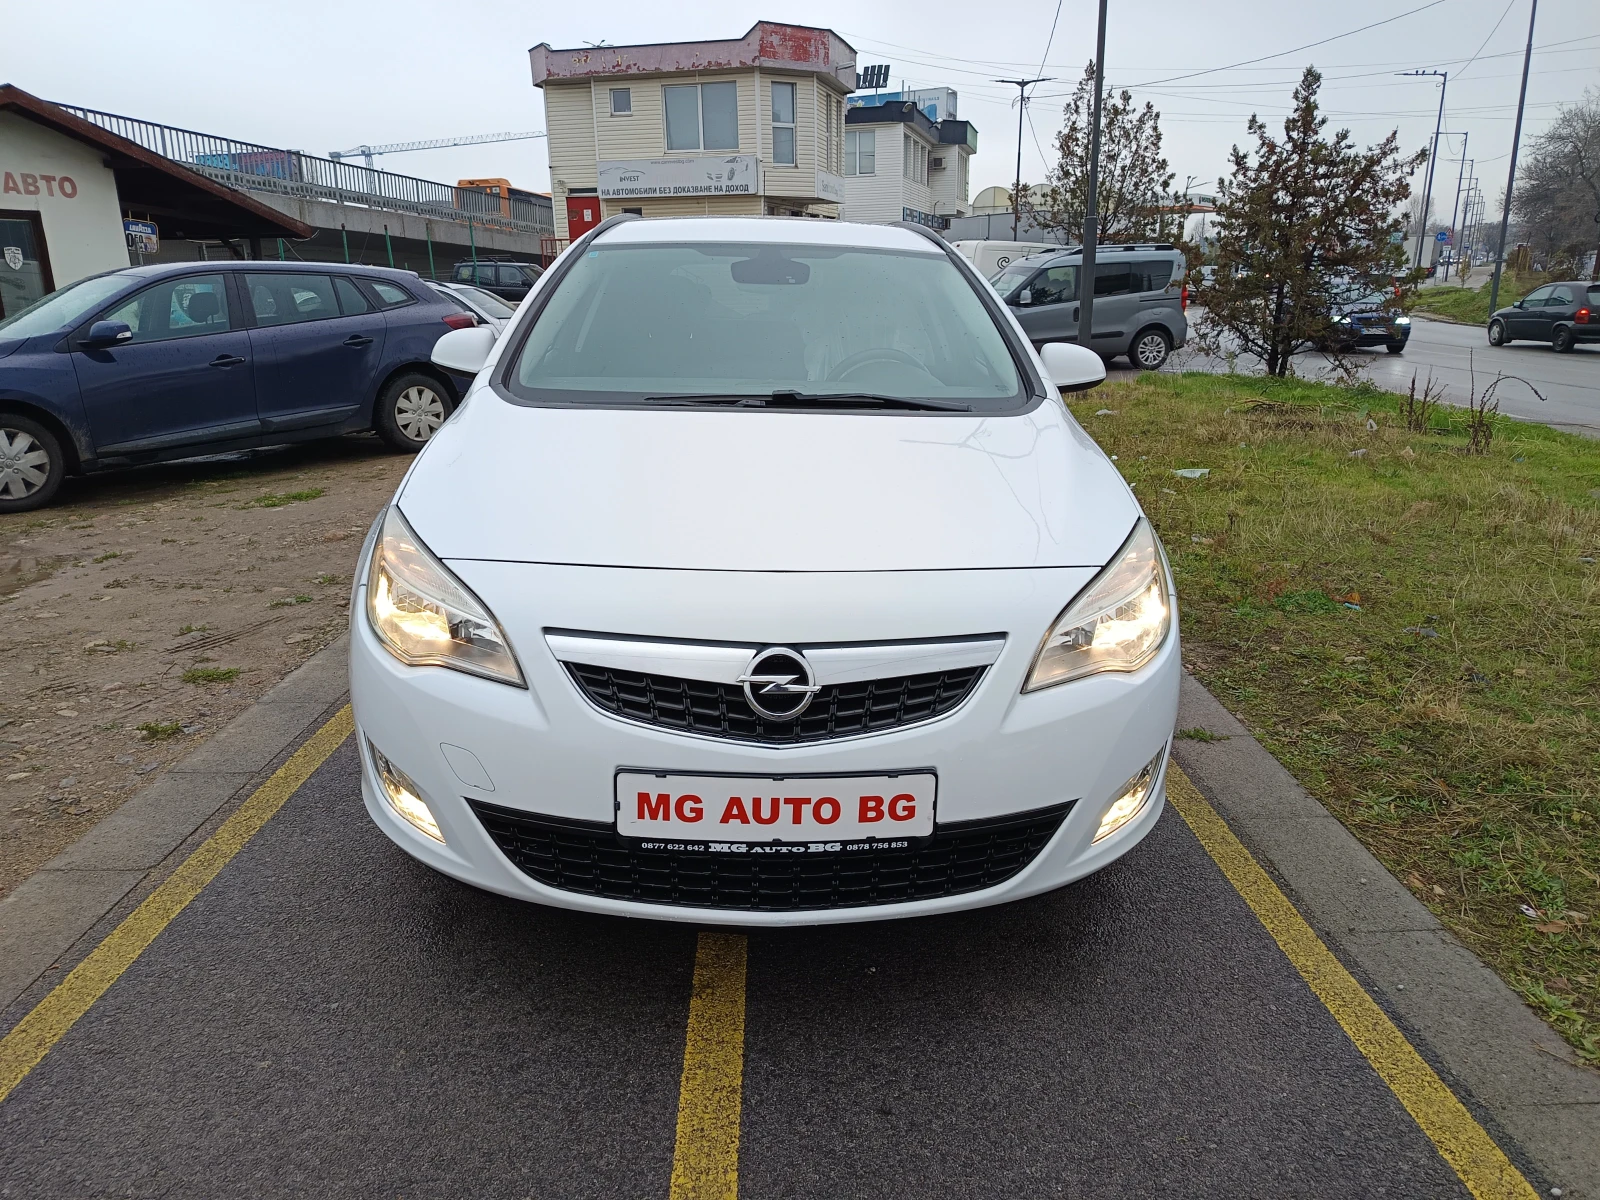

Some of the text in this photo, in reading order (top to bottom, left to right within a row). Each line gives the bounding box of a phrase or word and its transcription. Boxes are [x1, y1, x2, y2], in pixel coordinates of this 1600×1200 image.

[3, 171, 78, 199] АВТО
[601, 184, 749, 196] НА АВТОМОБИЛИ БЕЗ ДОКАЗВАНЕ НА ДОХОД
[637, 791, 916, 825] MG AUTO BG
[641, 842, 665, 850] 0877
[667, 843, 685, 851] 622
[708, 842, 749, 853] MG
[807, 842, 843, 853] BG
[846, 843, 870, 851] 0878
